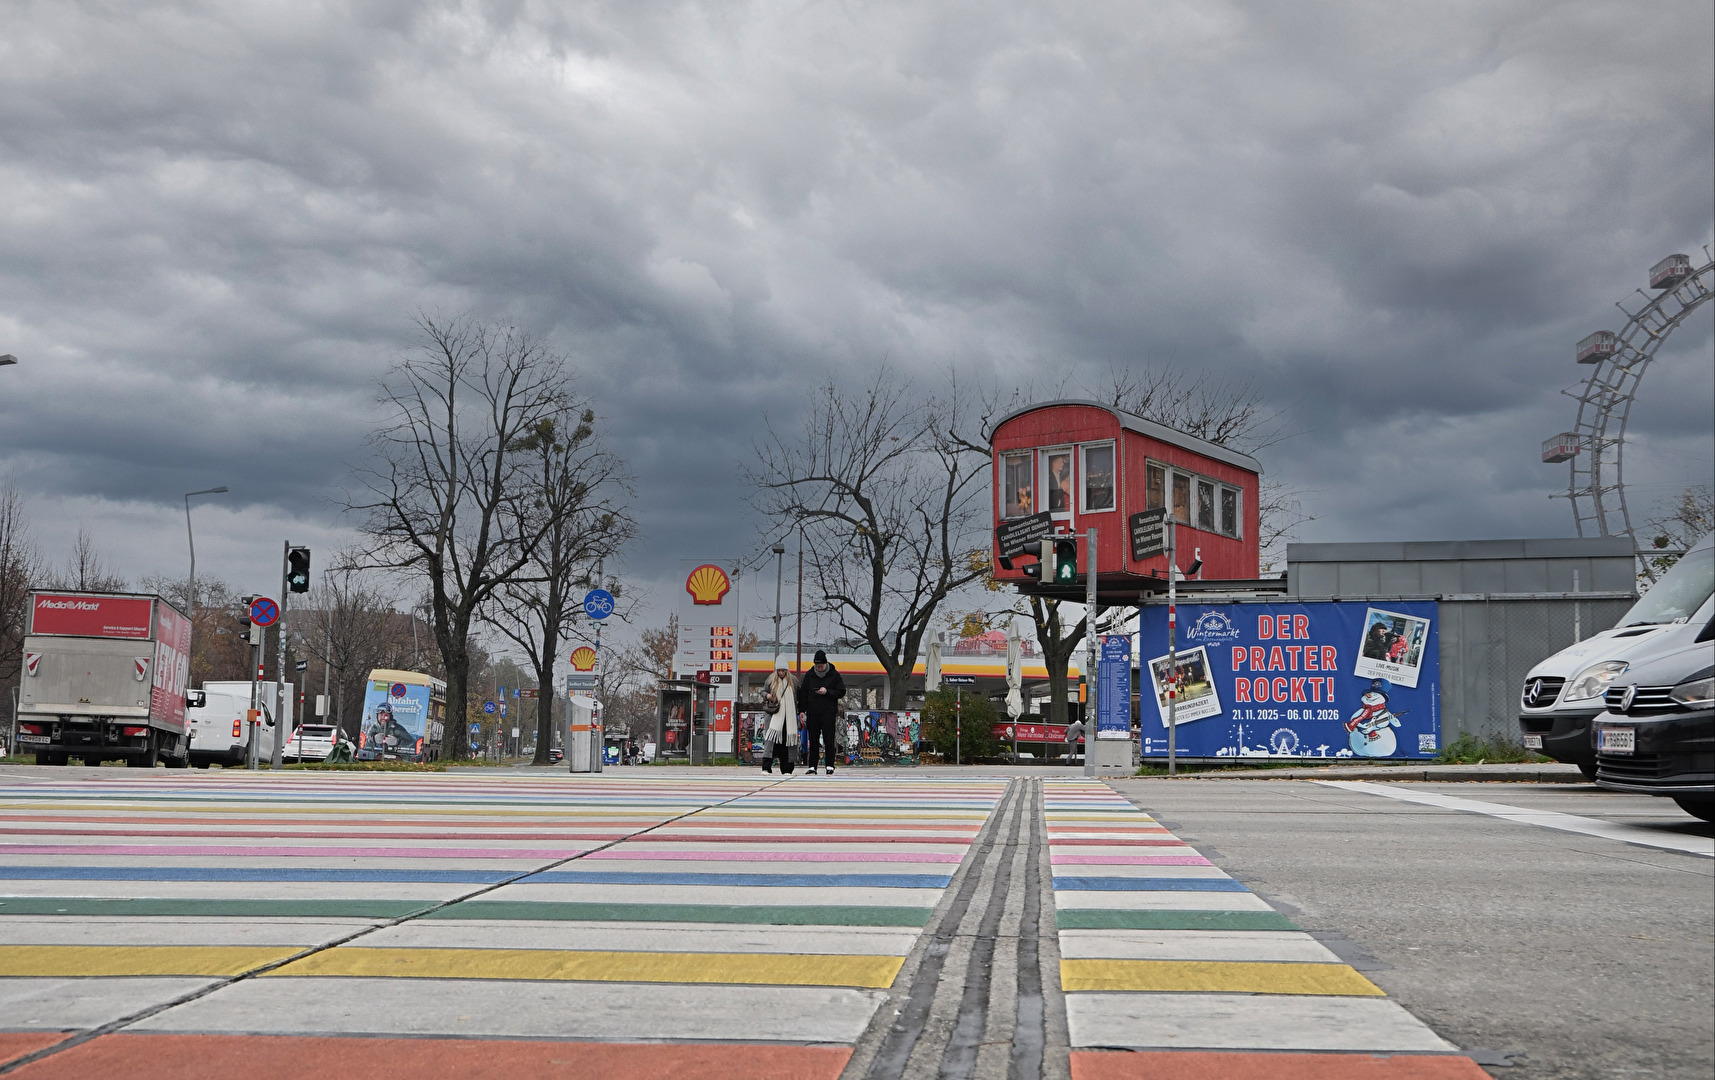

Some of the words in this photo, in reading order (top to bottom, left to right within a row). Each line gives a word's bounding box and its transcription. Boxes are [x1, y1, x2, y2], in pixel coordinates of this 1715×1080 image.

[1001, 527, 1030, 541] CANDLELIGHT
[1031, 521, 1049, 530] DINNER
[1010, 536, 1026, 545] Wiener
[1026, 528, 1050, 540] Riesenrad
[1186, 626, 1240, 639] Wintermarkt
[1258, 614, 1310, 640] DER
[1232, 646, 1337, 671] PRATER
[1235, 677, 1334, 702] ROCKT!
[388, 697, 420, 705] Abfahrt
[1232, 709, 1244, 720] 21.
[1246, 709, 1256, 720] 11.
[1257, 709, 1278, 720] 2025
[1287, 709, 1301, 720] 06.
[1303, 709, 1315, 720] 01.
[1317, 709, 1339, 720] 2026
